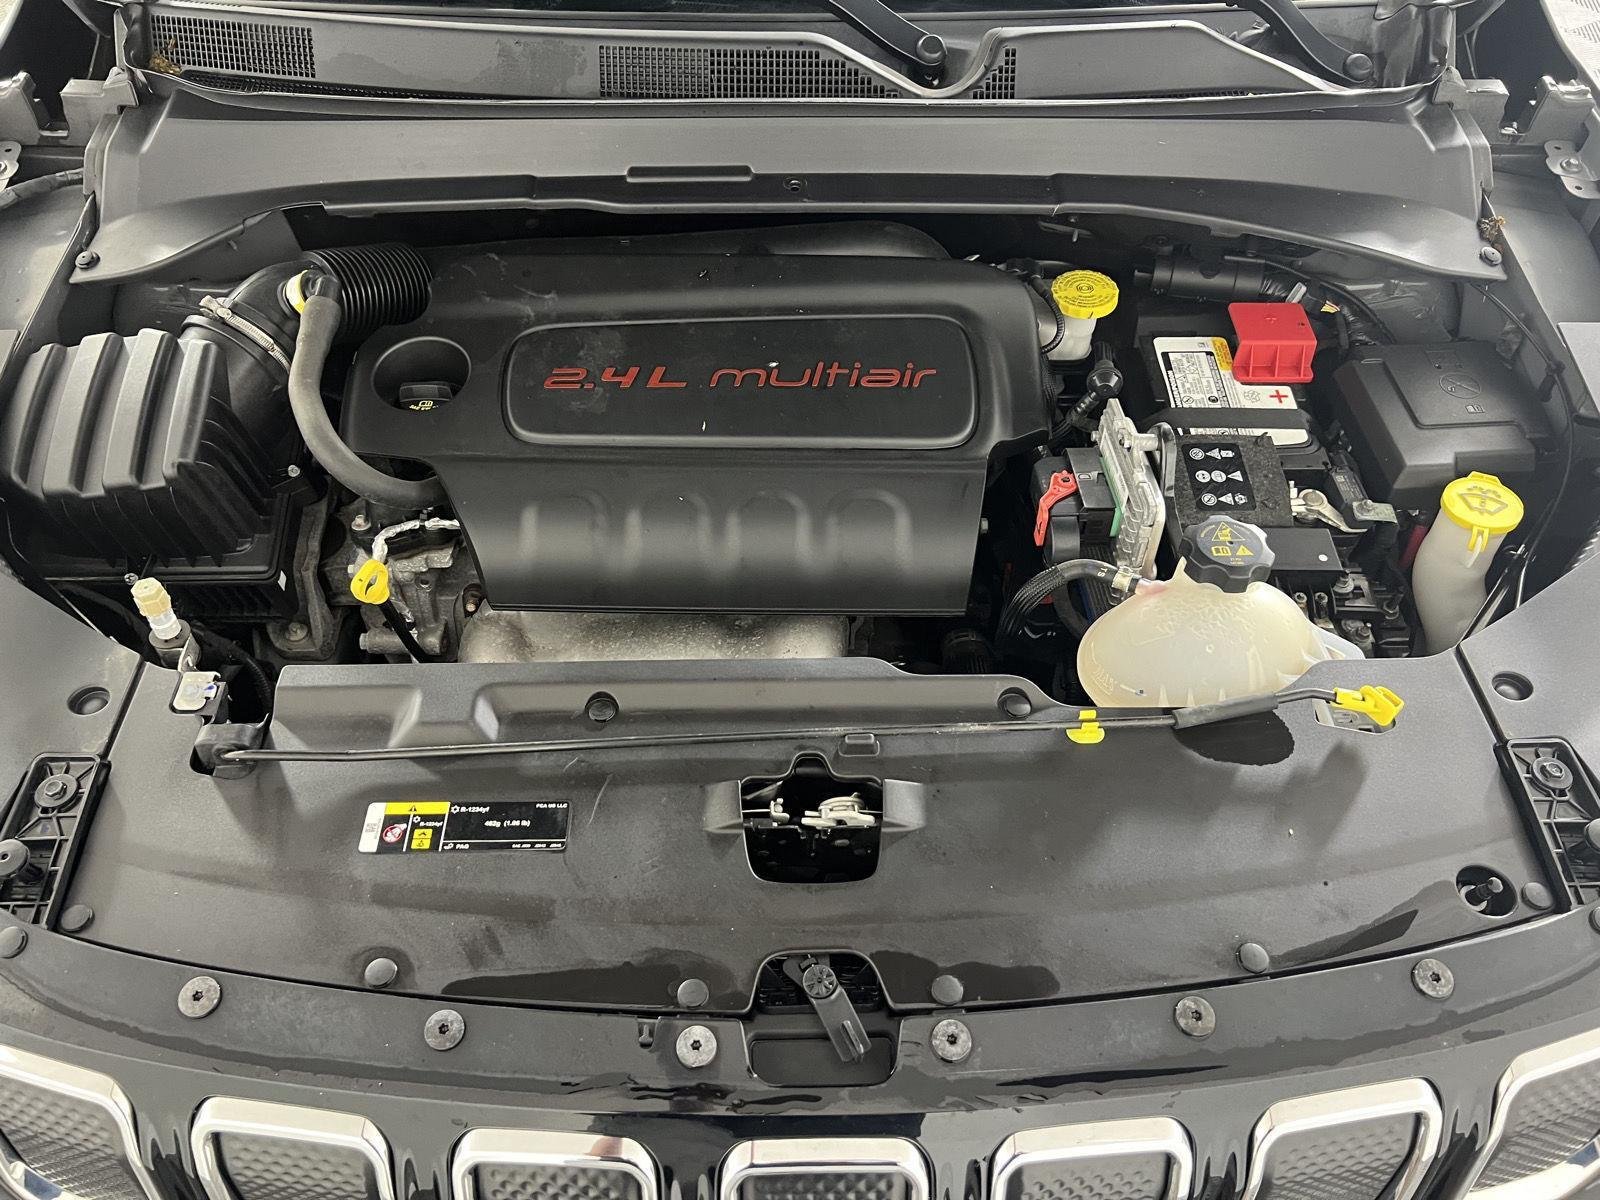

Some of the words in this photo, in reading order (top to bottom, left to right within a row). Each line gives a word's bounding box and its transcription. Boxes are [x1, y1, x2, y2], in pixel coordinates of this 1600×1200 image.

[543, 366, 688, 389] 2.4L
[709, 360, 937, 388] multiair
[460, 806, 490, 814] R-1234yf
